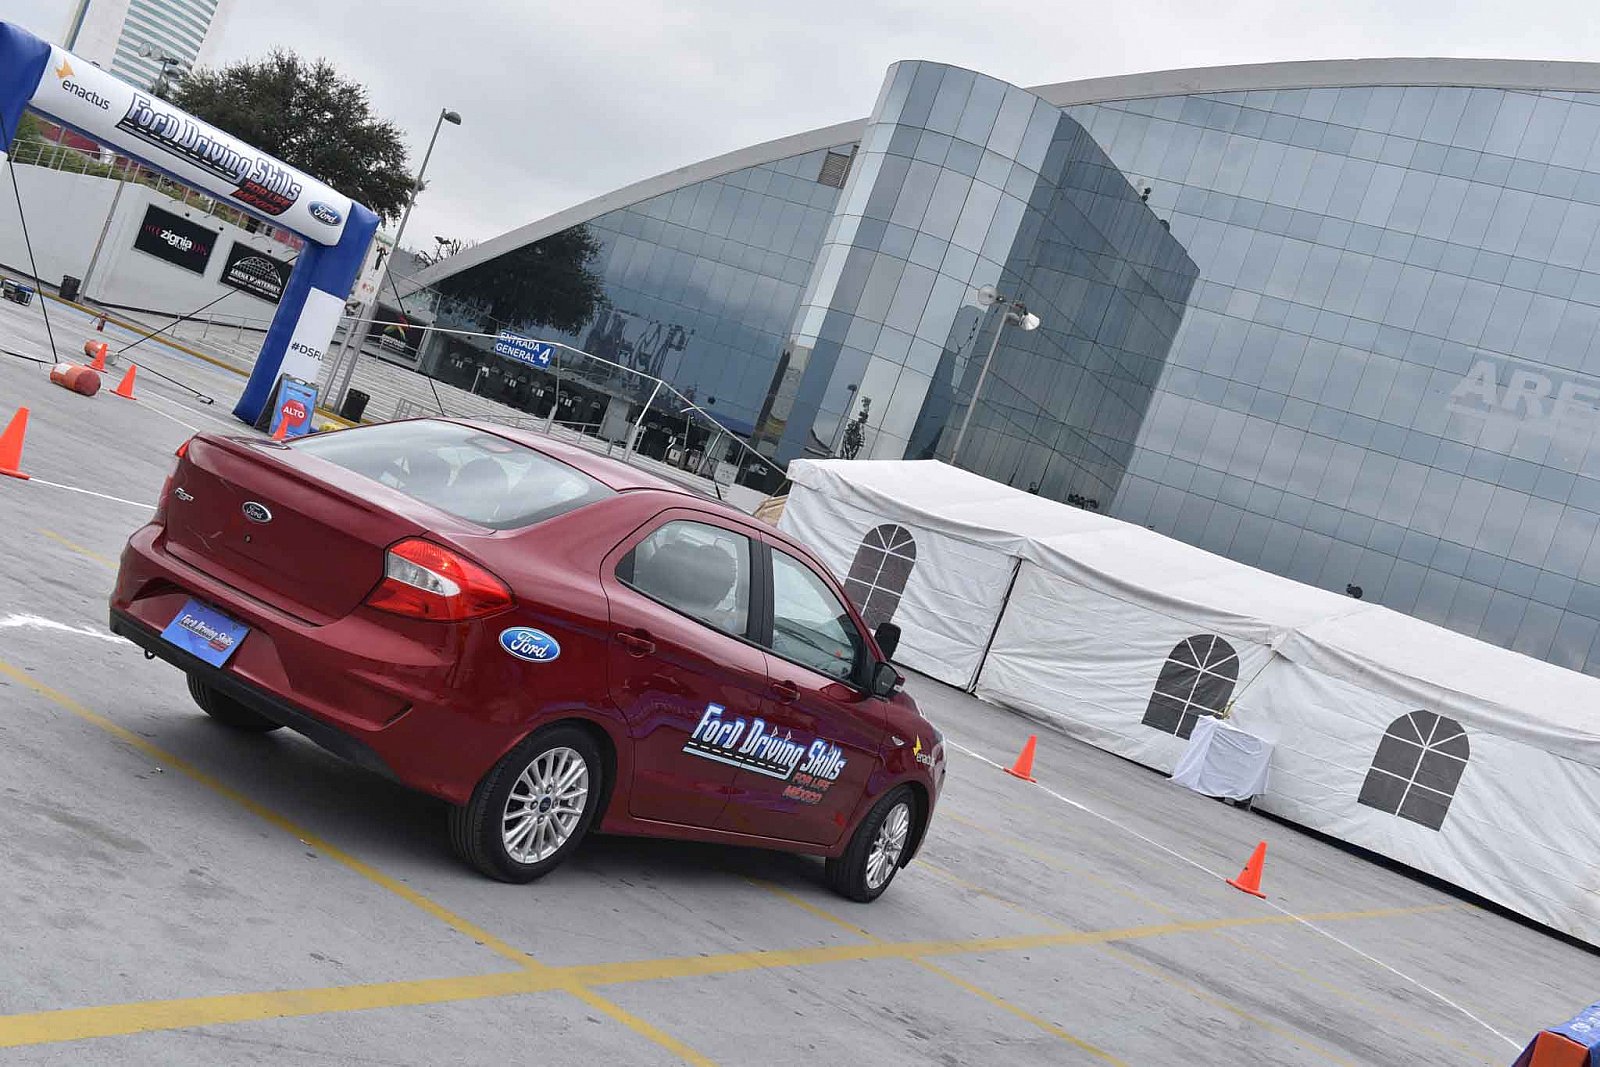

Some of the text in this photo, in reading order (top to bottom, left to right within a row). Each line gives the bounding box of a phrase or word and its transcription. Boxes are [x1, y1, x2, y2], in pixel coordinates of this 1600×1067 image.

[62, 79, 110, 110] enactus
[179, 119, 252, 184] Driving
[249, 157, 303, 202] Skills
[313, 205, 337, 223] Ford
[160, 229, 193, 249] zignia
[500, 332, 540, 352] ENTRADA
[496, 342, 551, 364] GENERAL 4
[283, 405, 305, 419] ALTO
[510, 631, 550, 659] Ford
[738, 717, 805, 780] Driving
[799, 737, 847, 781] Skills
[793, 771, 813, 785] FOR
